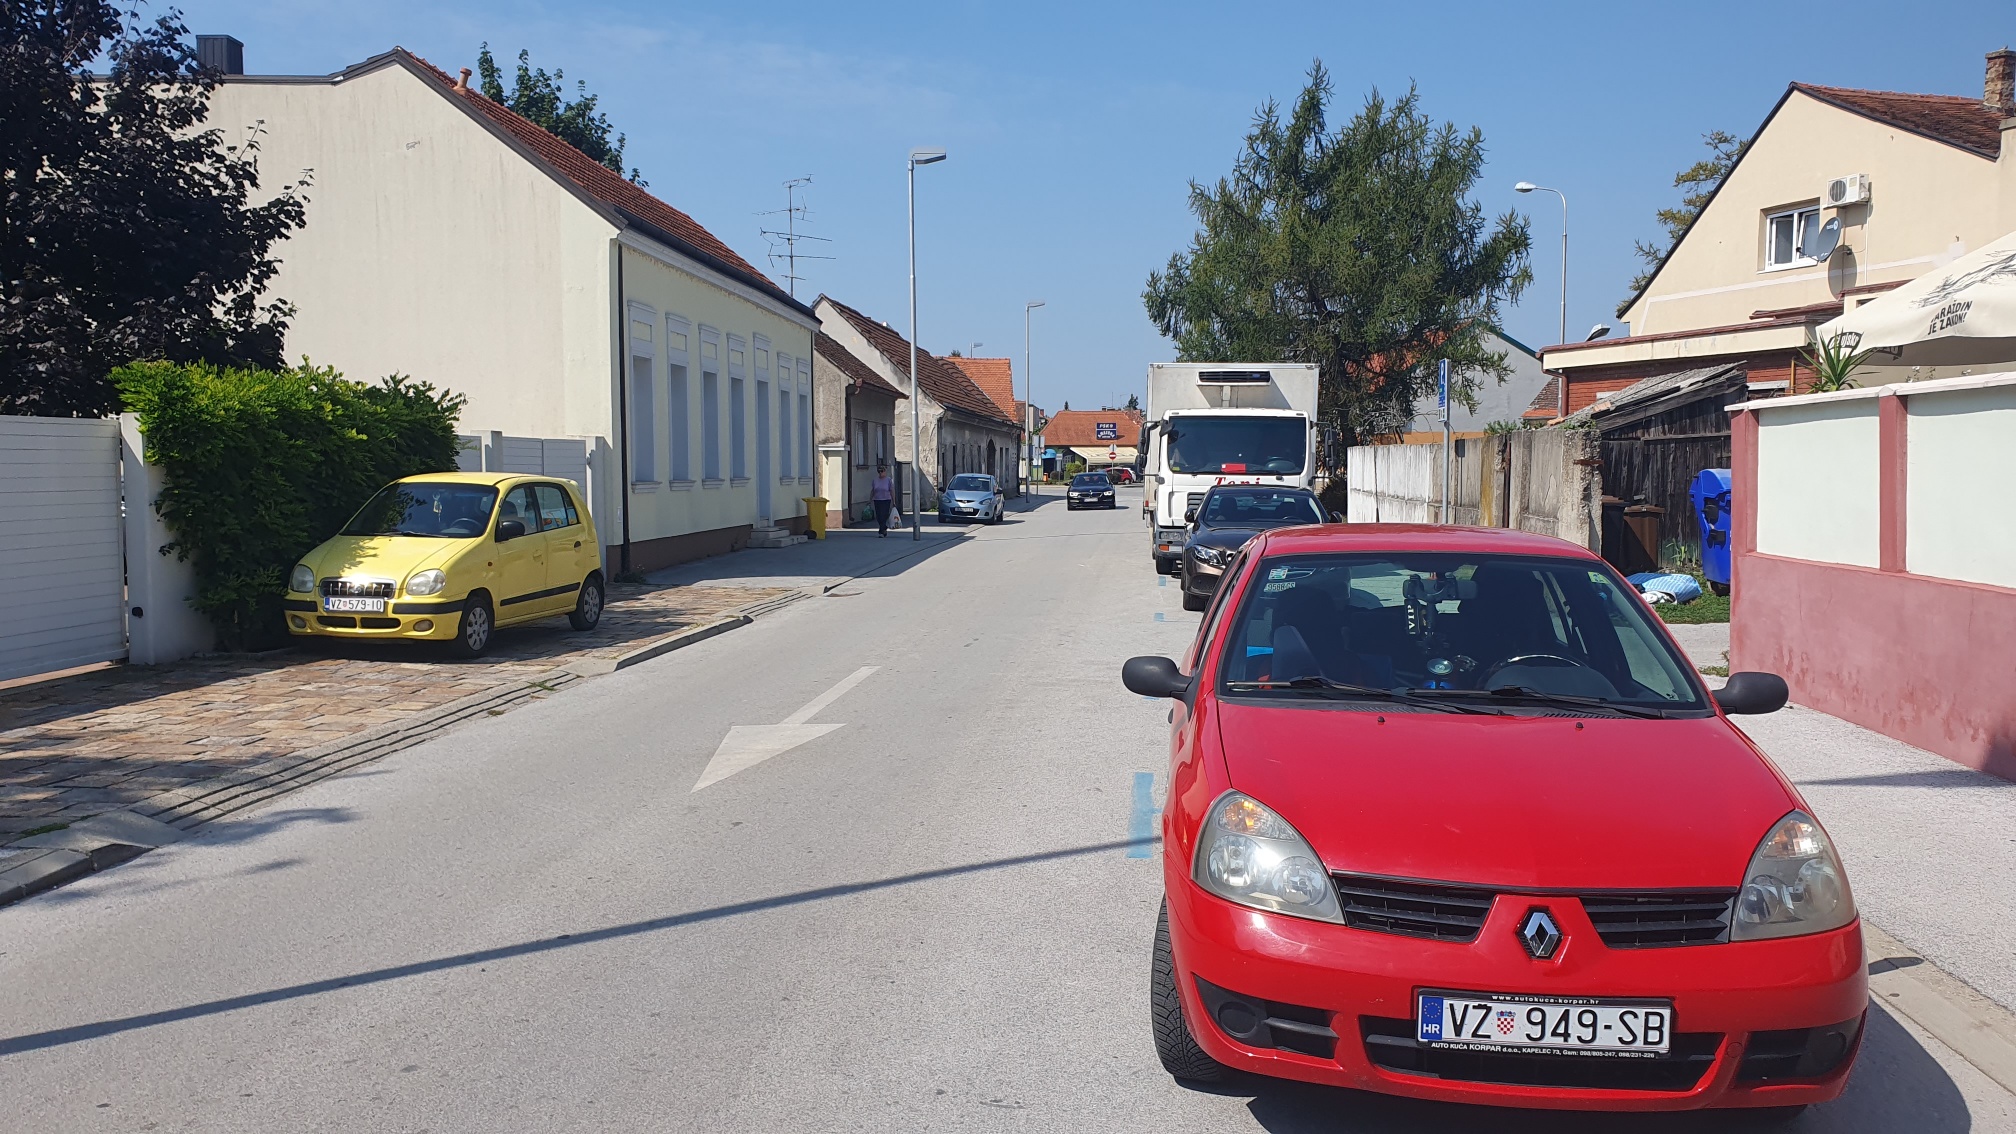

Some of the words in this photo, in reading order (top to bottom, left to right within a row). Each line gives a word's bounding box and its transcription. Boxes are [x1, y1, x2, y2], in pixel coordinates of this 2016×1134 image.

[1931, 300, 1973, 323] ARAŽDIN
[1928, 322, 1937, 336] JE
[1939, 312, 1968, 331] ZAKON!
[1407, 605, 1416, 630] VIP
[1491, 995, 1600, 1005] www.autokuca-korpar.hr
[1423, 1023, 1440, 1034] HR
[1525, 1007, 1666, 1046] 949-SB
[1469, 1043, 1502, 1052] KORPAR
